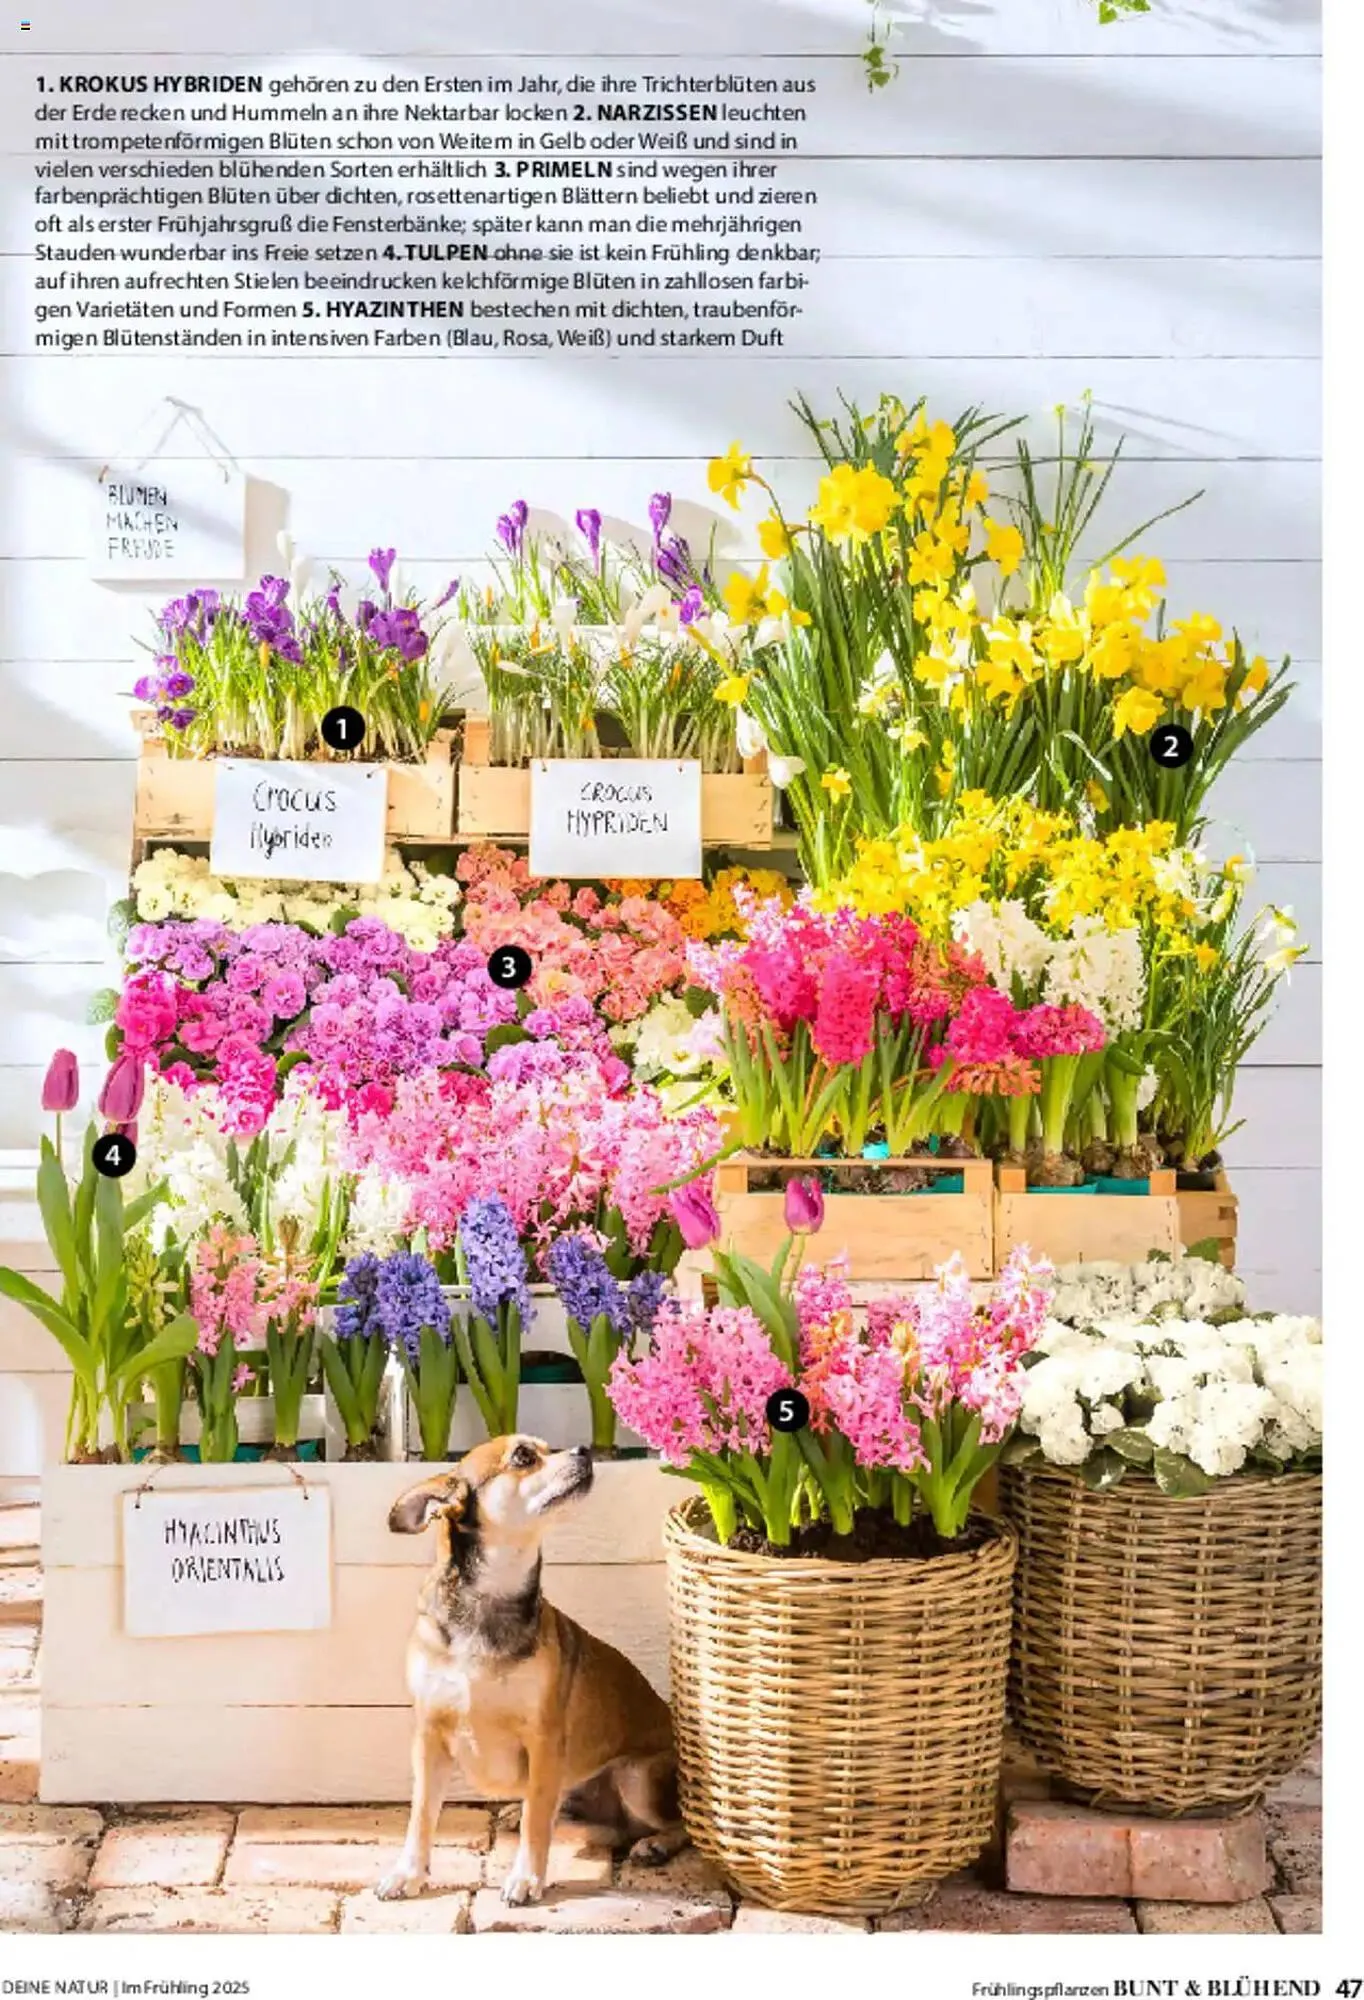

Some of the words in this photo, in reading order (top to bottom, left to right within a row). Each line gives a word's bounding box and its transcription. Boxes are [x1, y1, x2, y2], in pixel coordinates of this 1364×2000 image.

[108, 484, 167, 506] BLUMEN
[106, 511, 179, 534] MACHEN
[107, 537, 176, 559] FREUDE
[252, 780, 337, 812] Crocus
[580, 781, 653, 803] CROCUS
[164, 1517, 282, 1548] HYACINTHUS
[171, 1555, 285, 1584] ORIENTALIS
